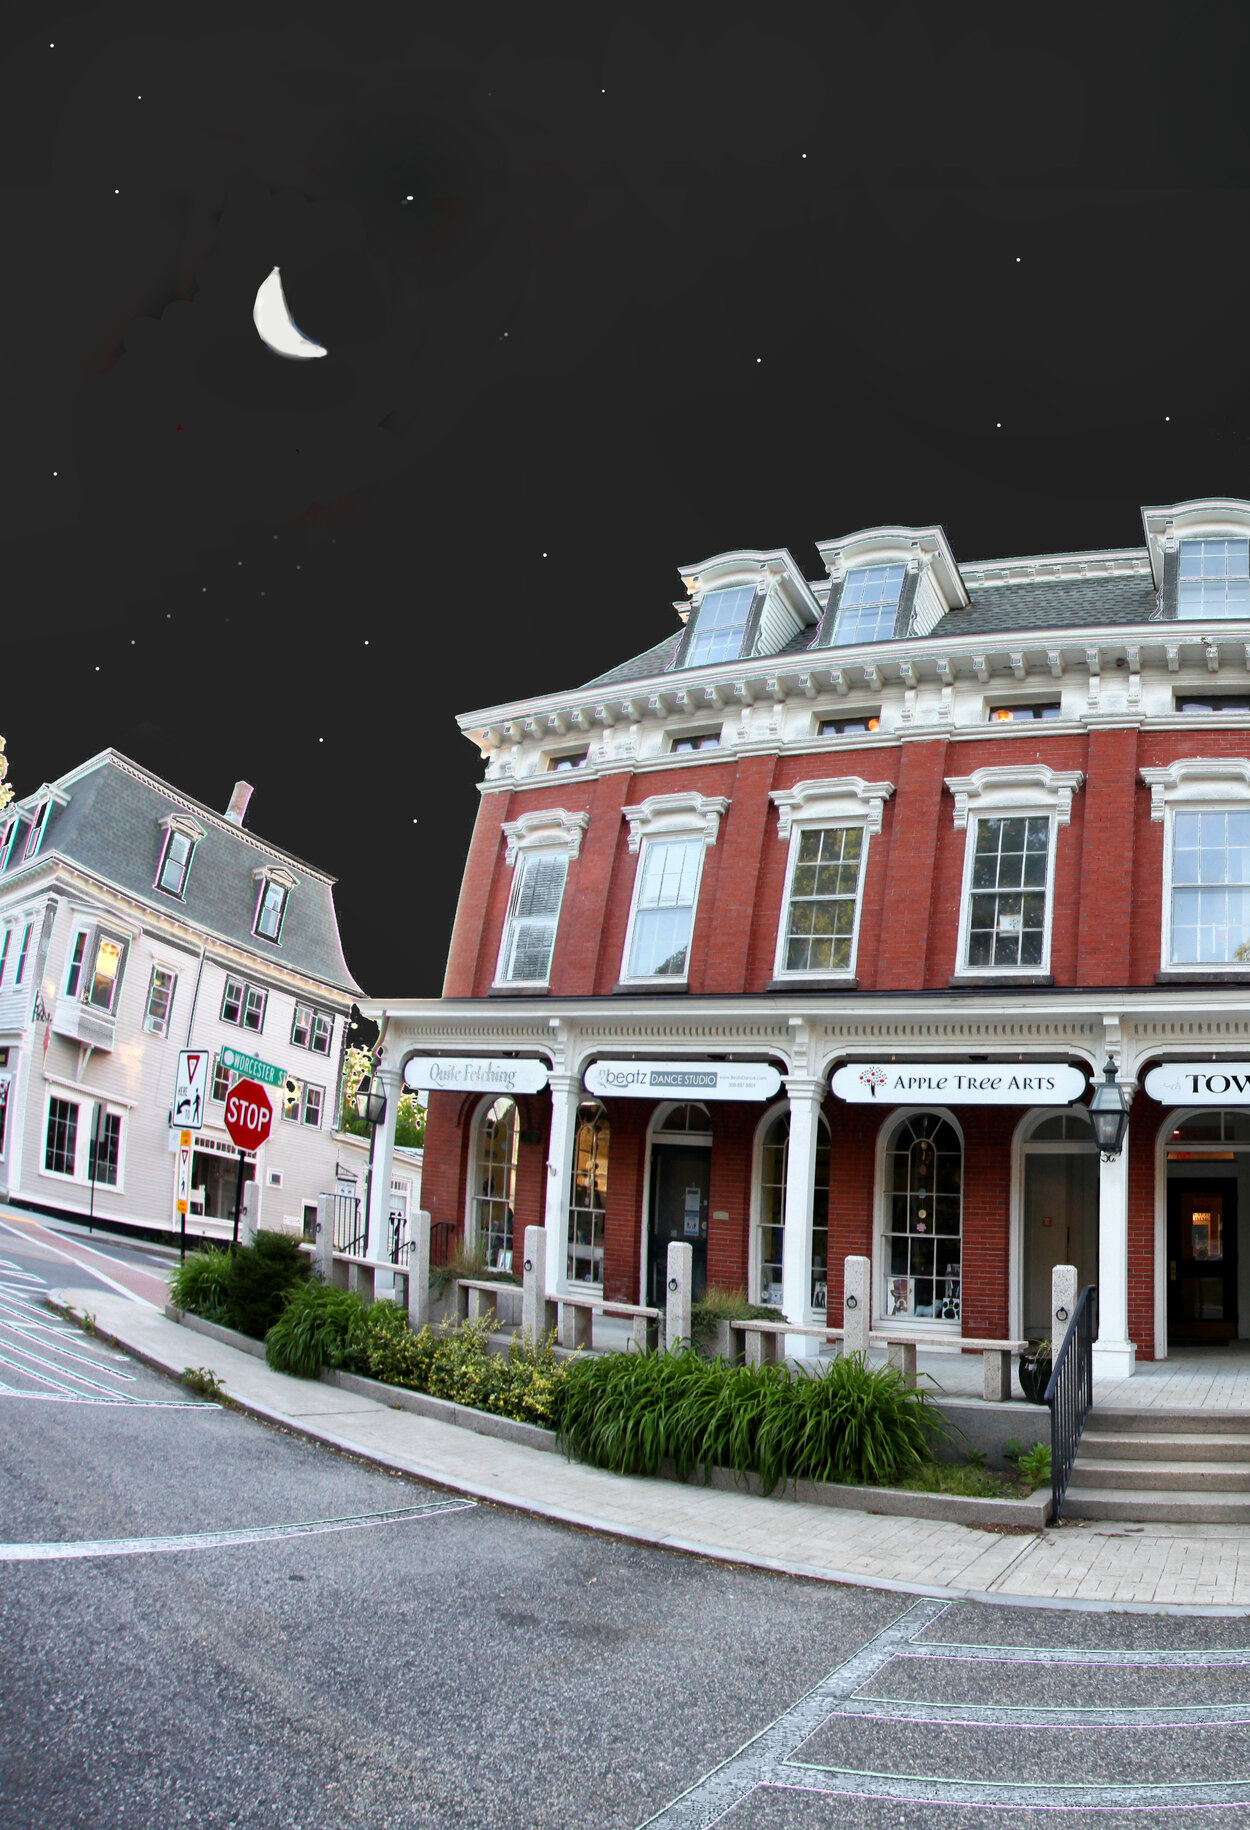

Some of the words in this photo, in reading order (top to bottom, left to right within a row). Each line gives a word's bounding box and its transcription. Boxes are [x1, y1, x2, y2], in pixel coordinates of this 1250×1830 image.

[233, 1053, 275, 1082] WORCESTER
[278, 1070, 287, 1086] ST
[429, 1062, 462, 1087] Quite
[463, 1061, 517, 1090] Fetching
[651, 1073, 684, 1084] DANCE
[684, 1074, 716, 1086] STUDIO
[227, 1097, 270, 1132] STOP
